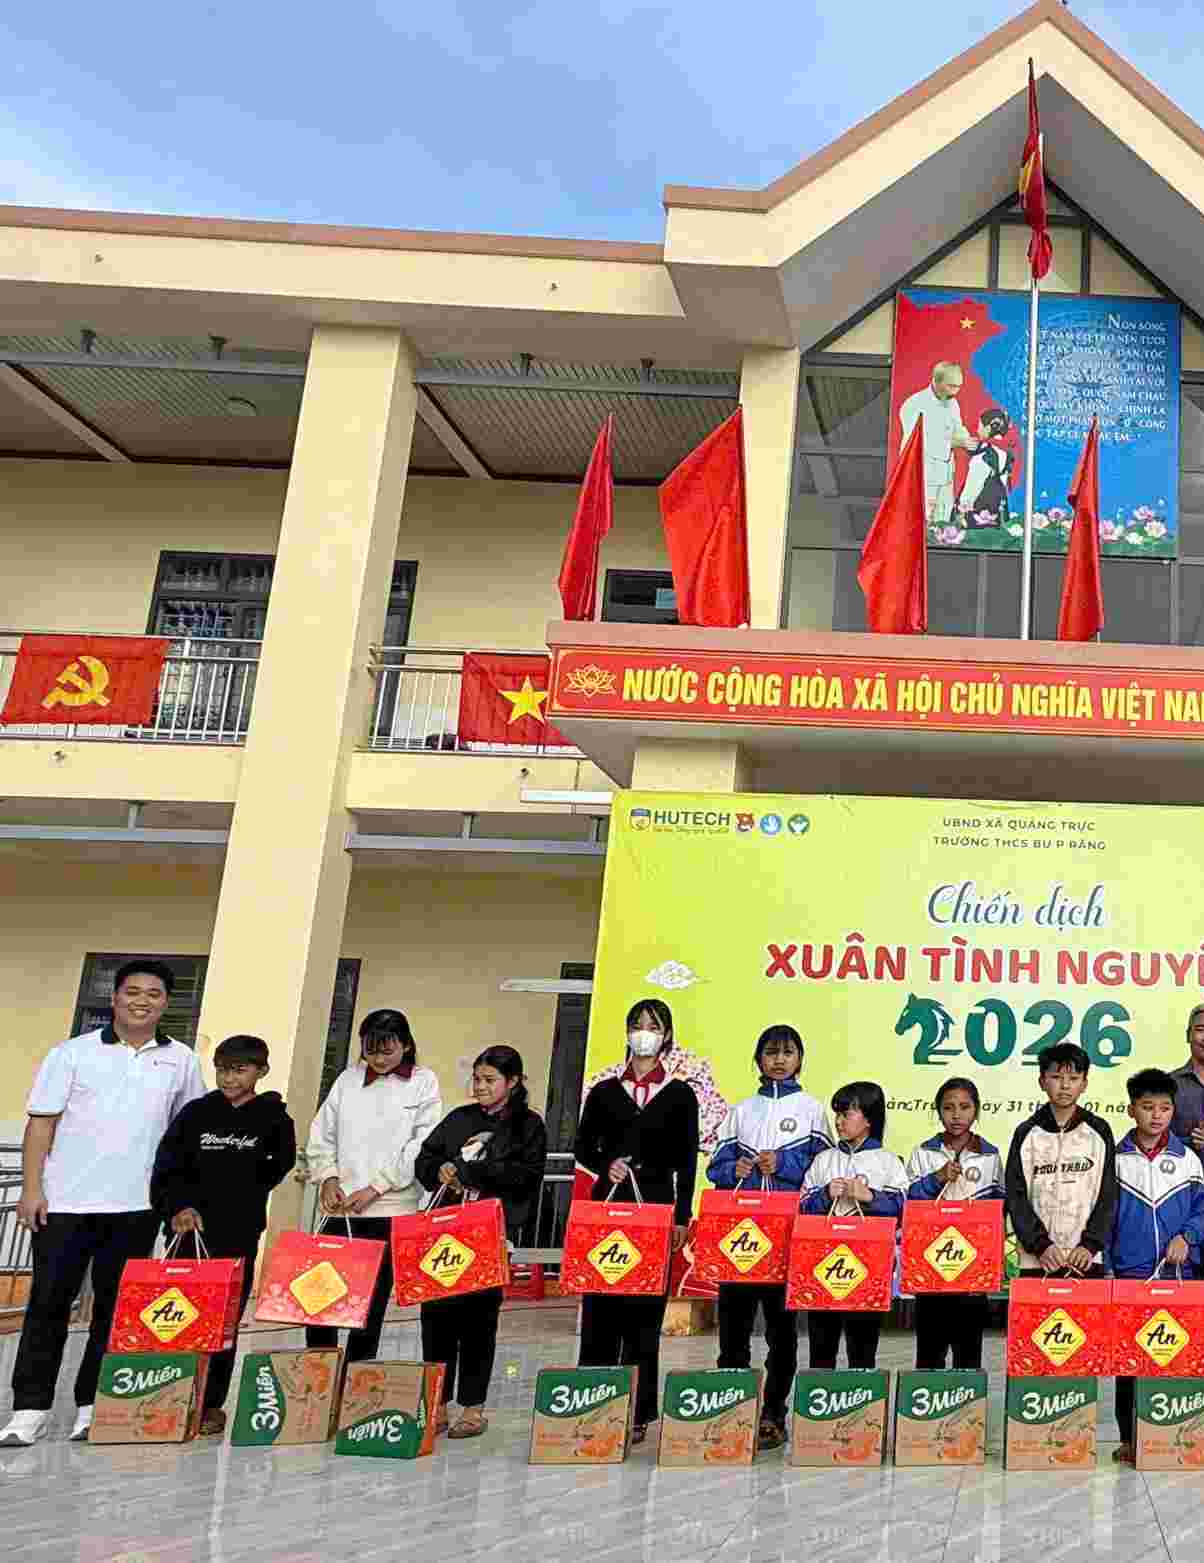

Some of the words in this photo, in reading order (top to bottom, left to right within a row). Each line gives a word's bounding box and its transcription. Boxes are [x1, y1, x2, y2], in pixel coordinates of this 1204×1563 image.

[622, 664, 699, 702] NƯỚC
[707, 666, 782, 713] CỘNG
[789, 671, 845, 710] HÒA
[853, 671, 888, 712] XÃ
[897, 674, 942, 720] HỘI
[950, 673, 1003, 716] CHỦ
[1011, 680, 1093, 719] NGHĨA
[1101, 680, 1158, 727] VIỆT
[653, 810, 731, 826] HUTECH
[942, 817, 982, 829] UBND
[985, 816, 1003, 828] XÃ
[1007, 817, 1057, 831] QUẢNG
[1060, 820, 1096, 832] TRỰC
[932, 834, 990, 847] TRƯỜNG
[994, 838, 1029, 848] THCS
[927, 880, 1024, 928] Chiến
[1034, 881, 1105, 932] dịch
[765, 932, 908, 981] XUÂN
[921, 935, 1040, 985] TÌNH
[894, 993, 1133, 1068] 2026
[1006, 1100, 1023, 1113] 31
[1084, 1101, 1101, 1113] 01
[730, 1231, 761, 1252] An
[935, 1239, 967, 1262] An
[431, 1246, 464, 1271] An
[599, 1243, 629, 1264] An
[824, 1257, 858, 1281] An
[150, 1300, 186, 1323] An
[1042, 1322, 1076, 1345] An
[1146, 1323, 1178, 1347] An
